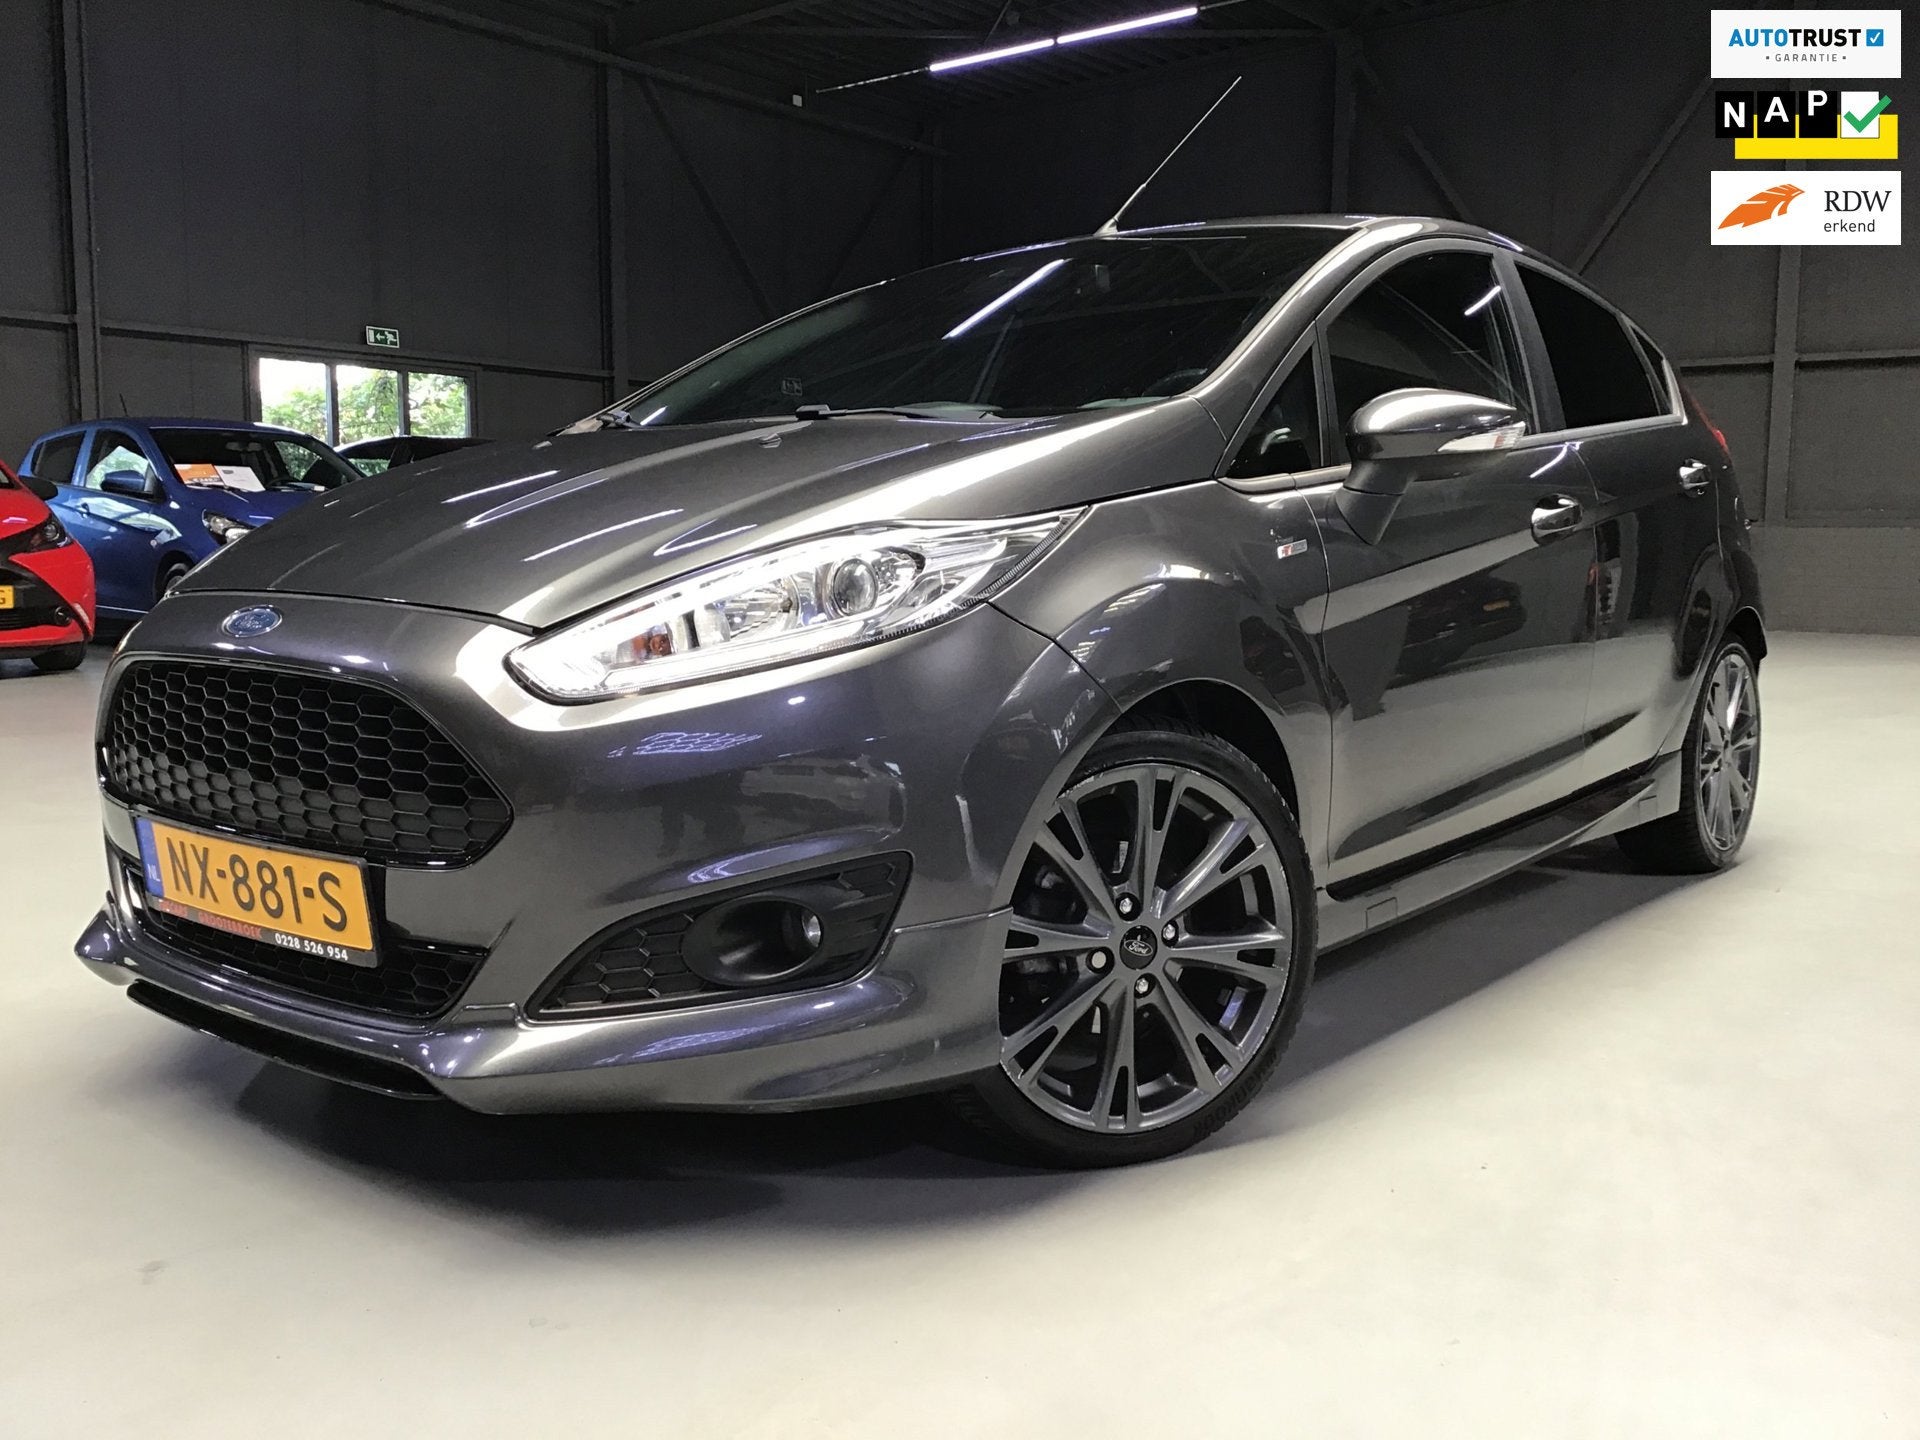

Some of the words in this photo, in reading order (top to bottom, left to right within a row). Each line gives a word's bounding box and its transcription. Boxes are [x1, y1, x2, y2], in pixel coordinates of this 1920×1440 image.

[166, 837, 348, 932] NX-881-S
[274, 932, 301, 949] 0228
[303, 939, 324, 955] 526
[326, 945, 348, 961] 954
[1128, 940, 1149, 955] Ford
